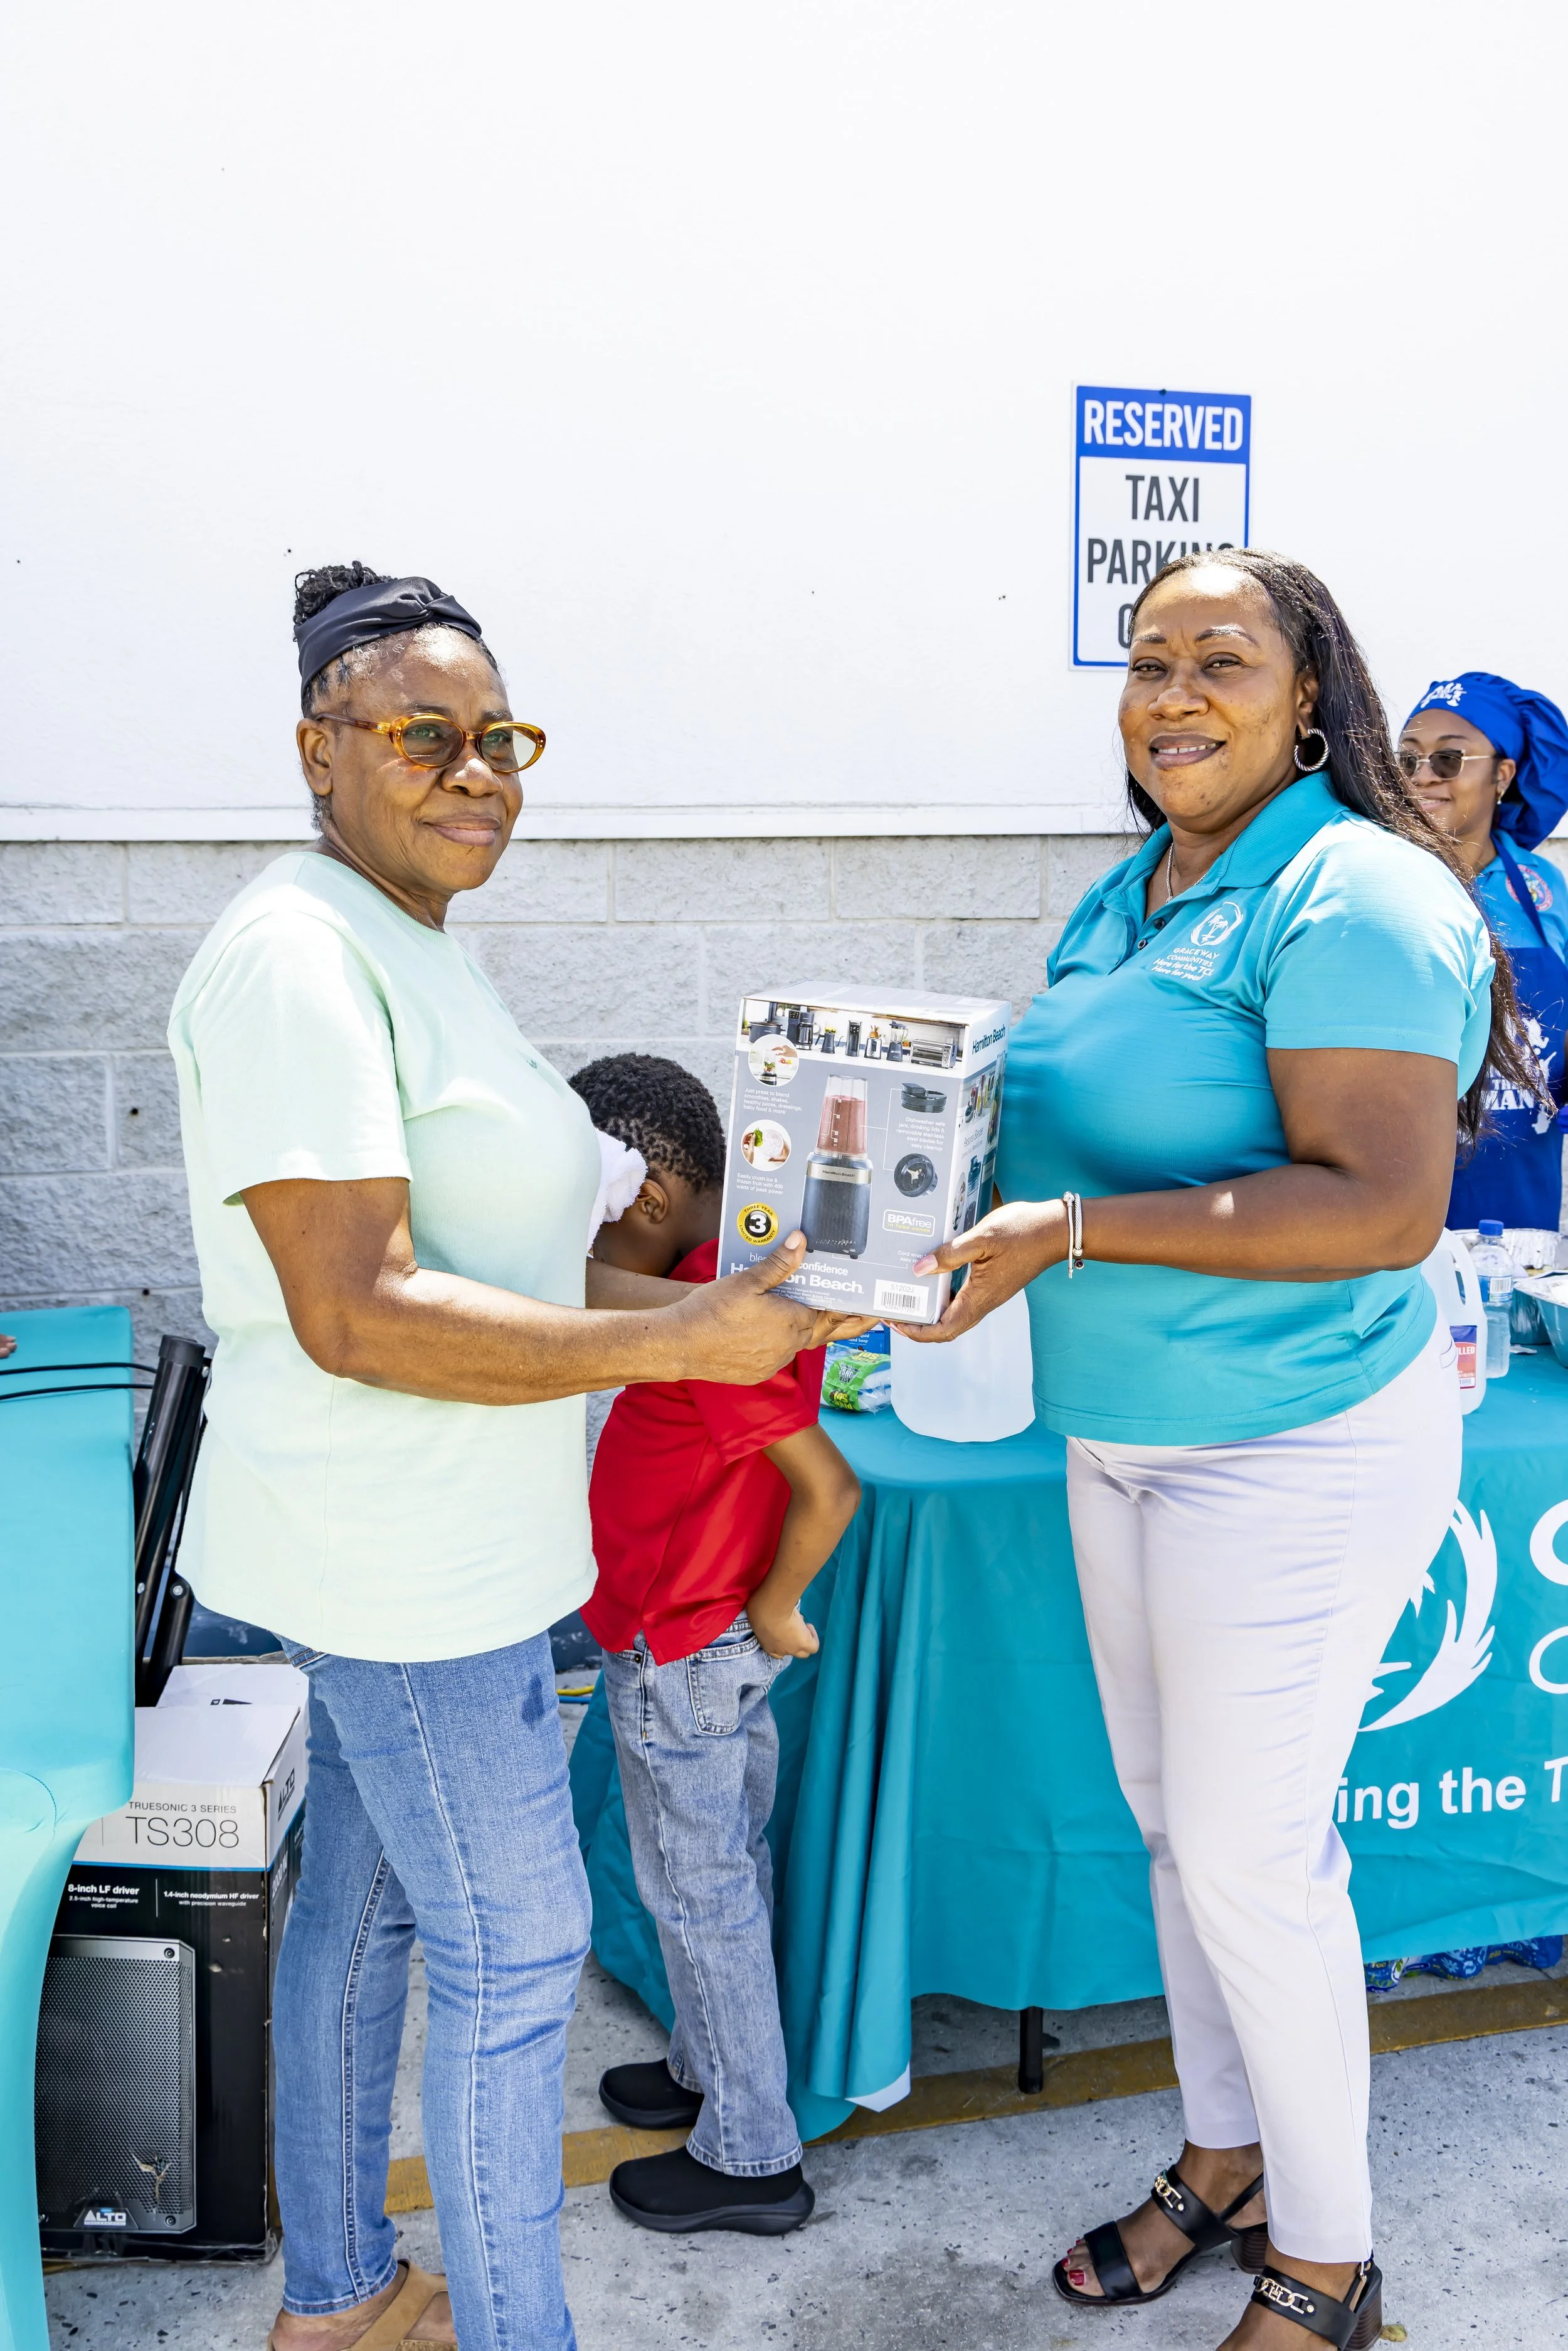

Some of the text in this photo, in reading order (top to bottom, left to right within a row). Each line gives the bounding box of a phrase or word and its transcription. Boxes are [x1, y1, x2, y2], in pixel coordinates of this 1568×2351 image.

[1084, 400, 1242, 451] RESERVED
[1126, 474, 1199, 522] TAXI
[1088, 538, 1234, 585] PARK
[1173, 947, 1219, 960] GRACEWAY
[1167, 954, 1214, 967] COMMUNITIES
[1183, 963, 1197, 972] the
[972, 1024, 1005, 1055] Hamilton Beach
[906, 1117, 934, 1125] Dishwasher
[910, 1123, 930, 1132] drinking
[761, 1206, 773, 1216] YEAR
[749, 1214, 766, 1233] 3
[739, 1224, 775, 1243] LIMITED WARRANTY
[750, 1252, 767, 1263] ble
[798, 1262, 848, 1276] confidence
[1439, 1767, 1526, 1814] the
[129, 1802, 236, 1813] TRUESONIC 3 SERIES
[125, 1816, 239, 1848] TS308
[68, 1884, 139, 1894] 8-inch LF driver
[164, 1891, 189, 1899] 1.4-inch
[189, 1892, 228, 1900] neodymium
[84, 2210, 126, 2222] ALTO
